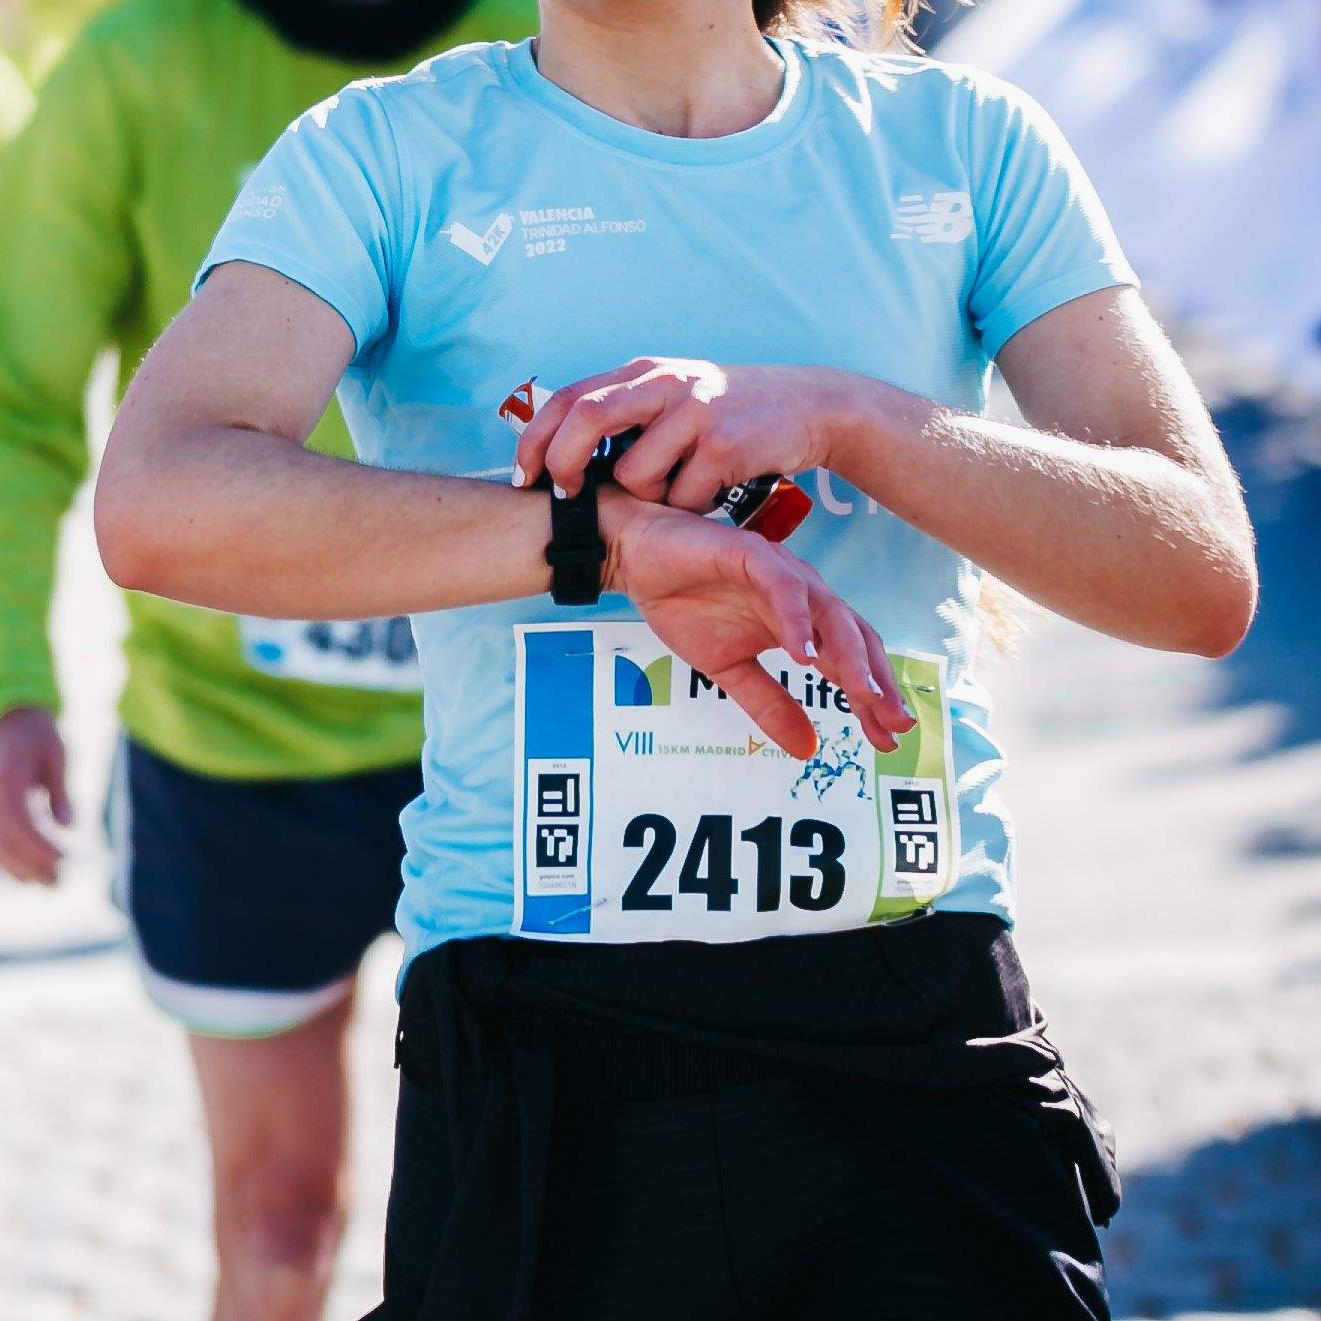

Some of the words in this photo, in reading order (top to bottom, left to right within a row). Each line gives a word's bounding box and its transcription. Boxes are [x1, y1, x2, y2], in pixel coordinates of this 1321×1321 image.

[519, 207, 595, 224] VALENCIA
[525, 239, 566, 257] 2022
[695, 744, 746, 757] MADRID
[621, 813, 846, 913] 2413
